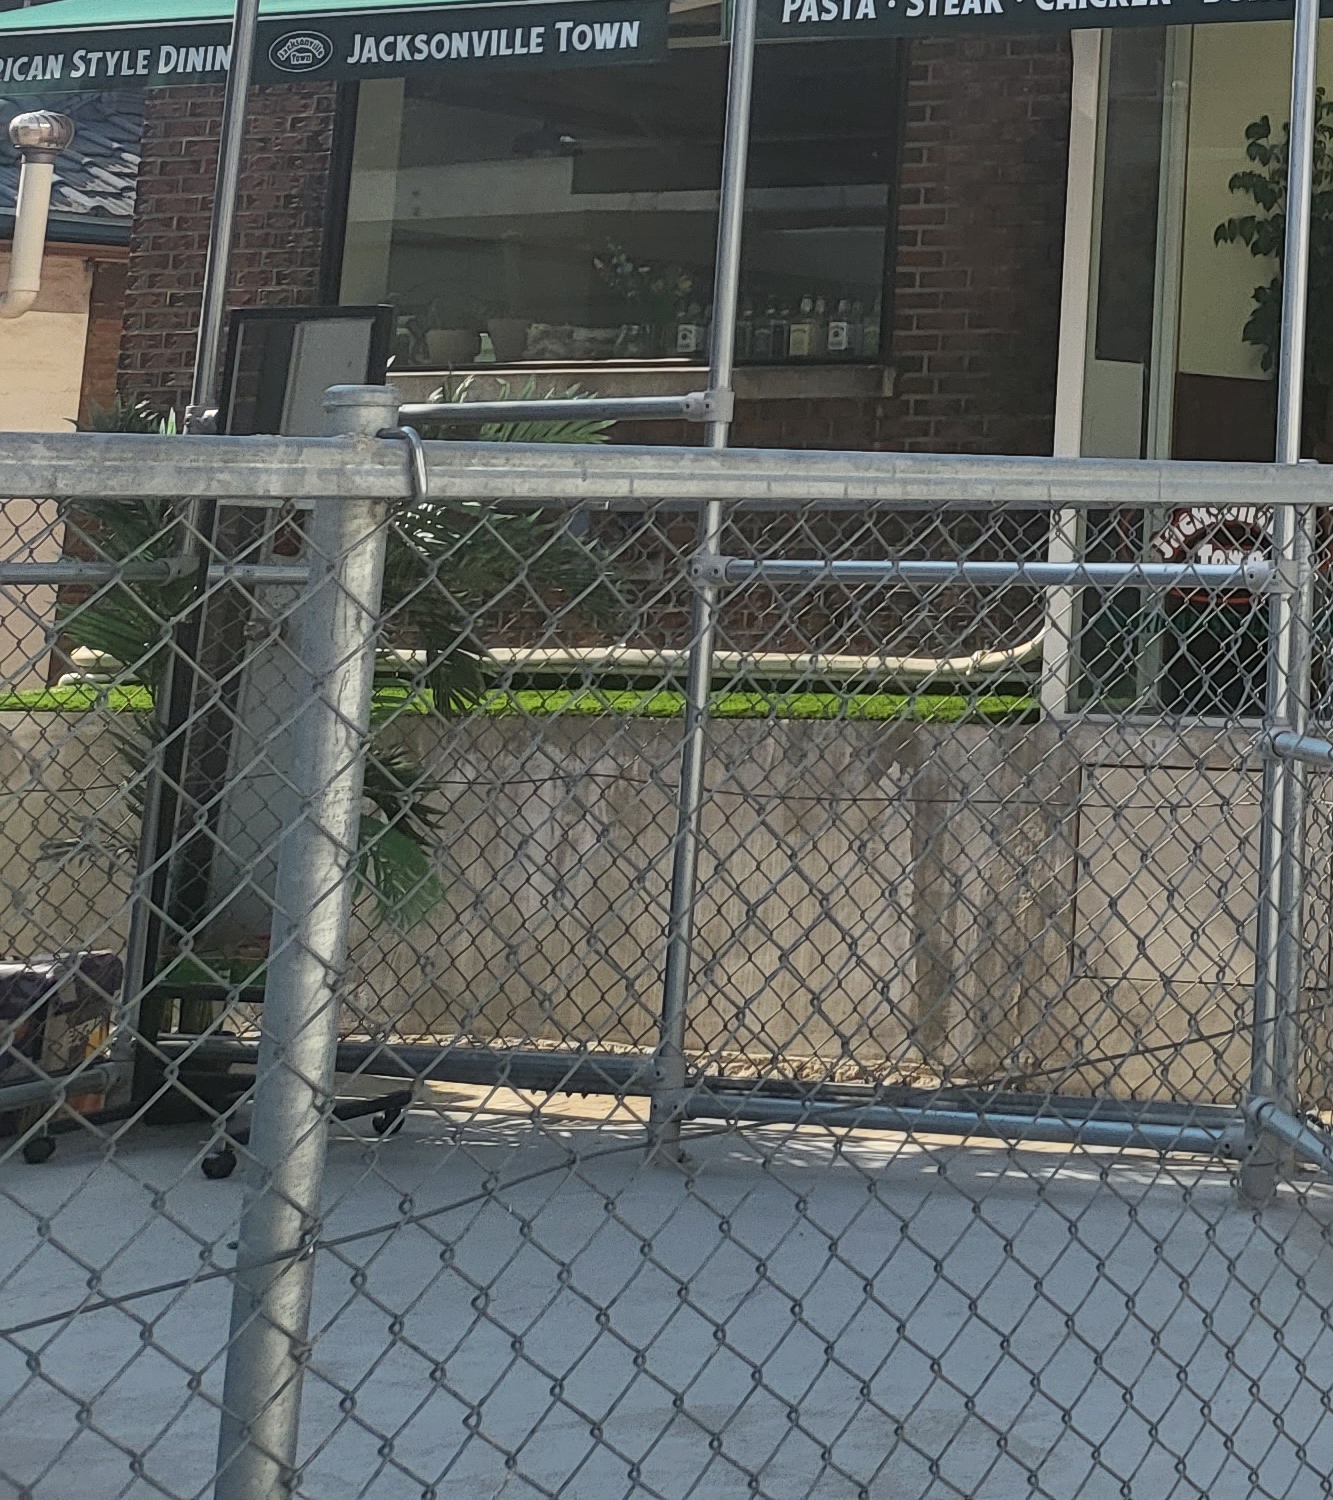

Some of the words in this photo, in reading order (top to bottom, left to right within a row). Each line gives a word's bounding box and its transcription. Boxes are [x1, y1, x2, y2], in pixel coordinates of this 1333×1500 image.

[277, 37, 325, 61] Jacksonville
[346, 26, 546, 65] JACKSONVILLE
[555, 20, 641, 53] TOWN
[70, 49, 151, 78] STYLE
[157, 44, 232, 74] DININ
[291, 52, 313, 65] Town
